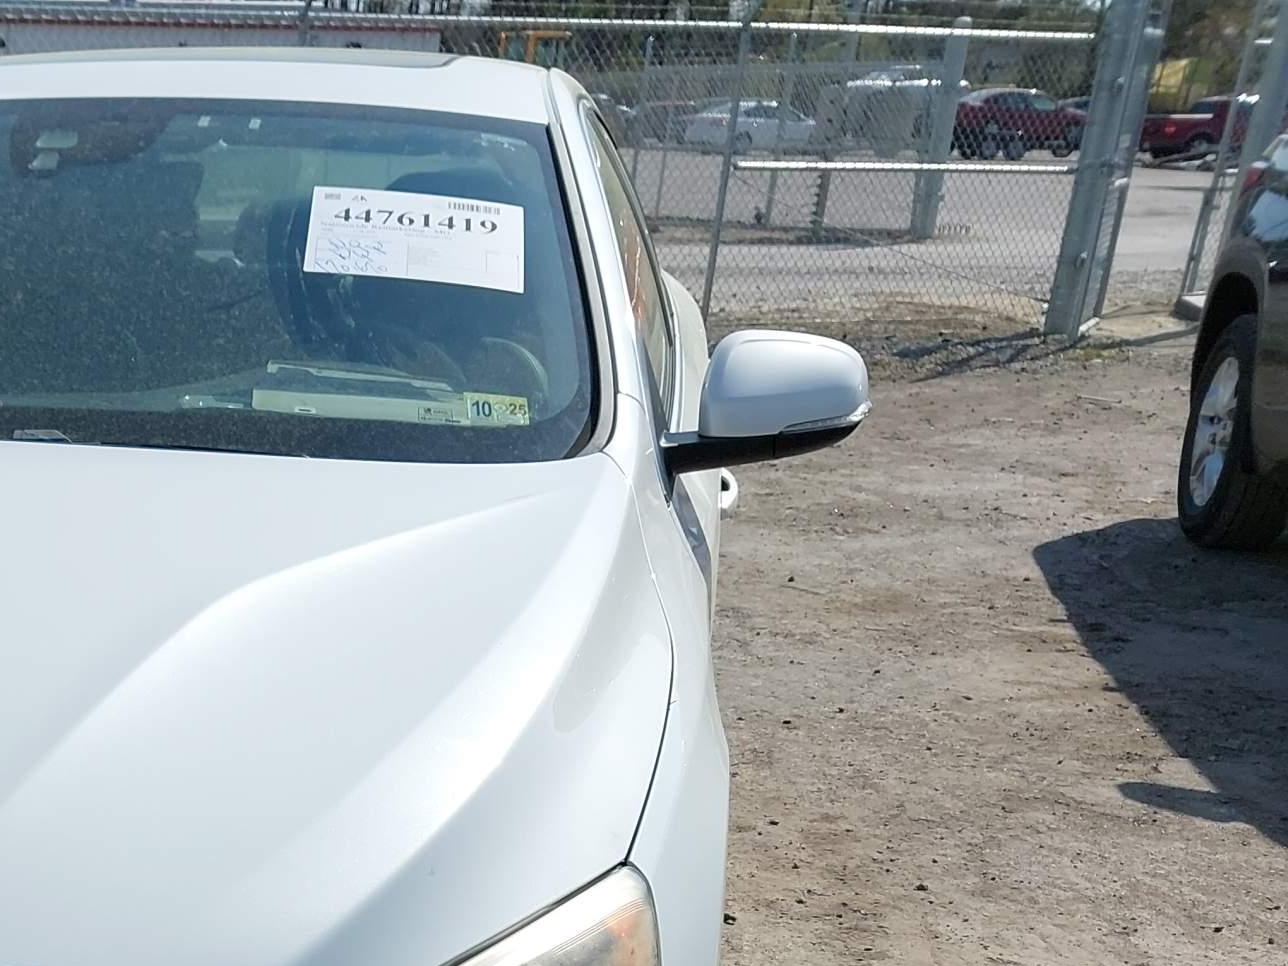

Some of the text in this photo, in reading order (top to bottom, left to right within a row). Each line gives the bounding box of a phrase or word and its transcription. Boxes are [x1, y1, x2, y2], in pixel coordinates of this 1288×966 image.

[334, 207, 499, 234] 44761419
[471, 400, 527, 418] 10 25
